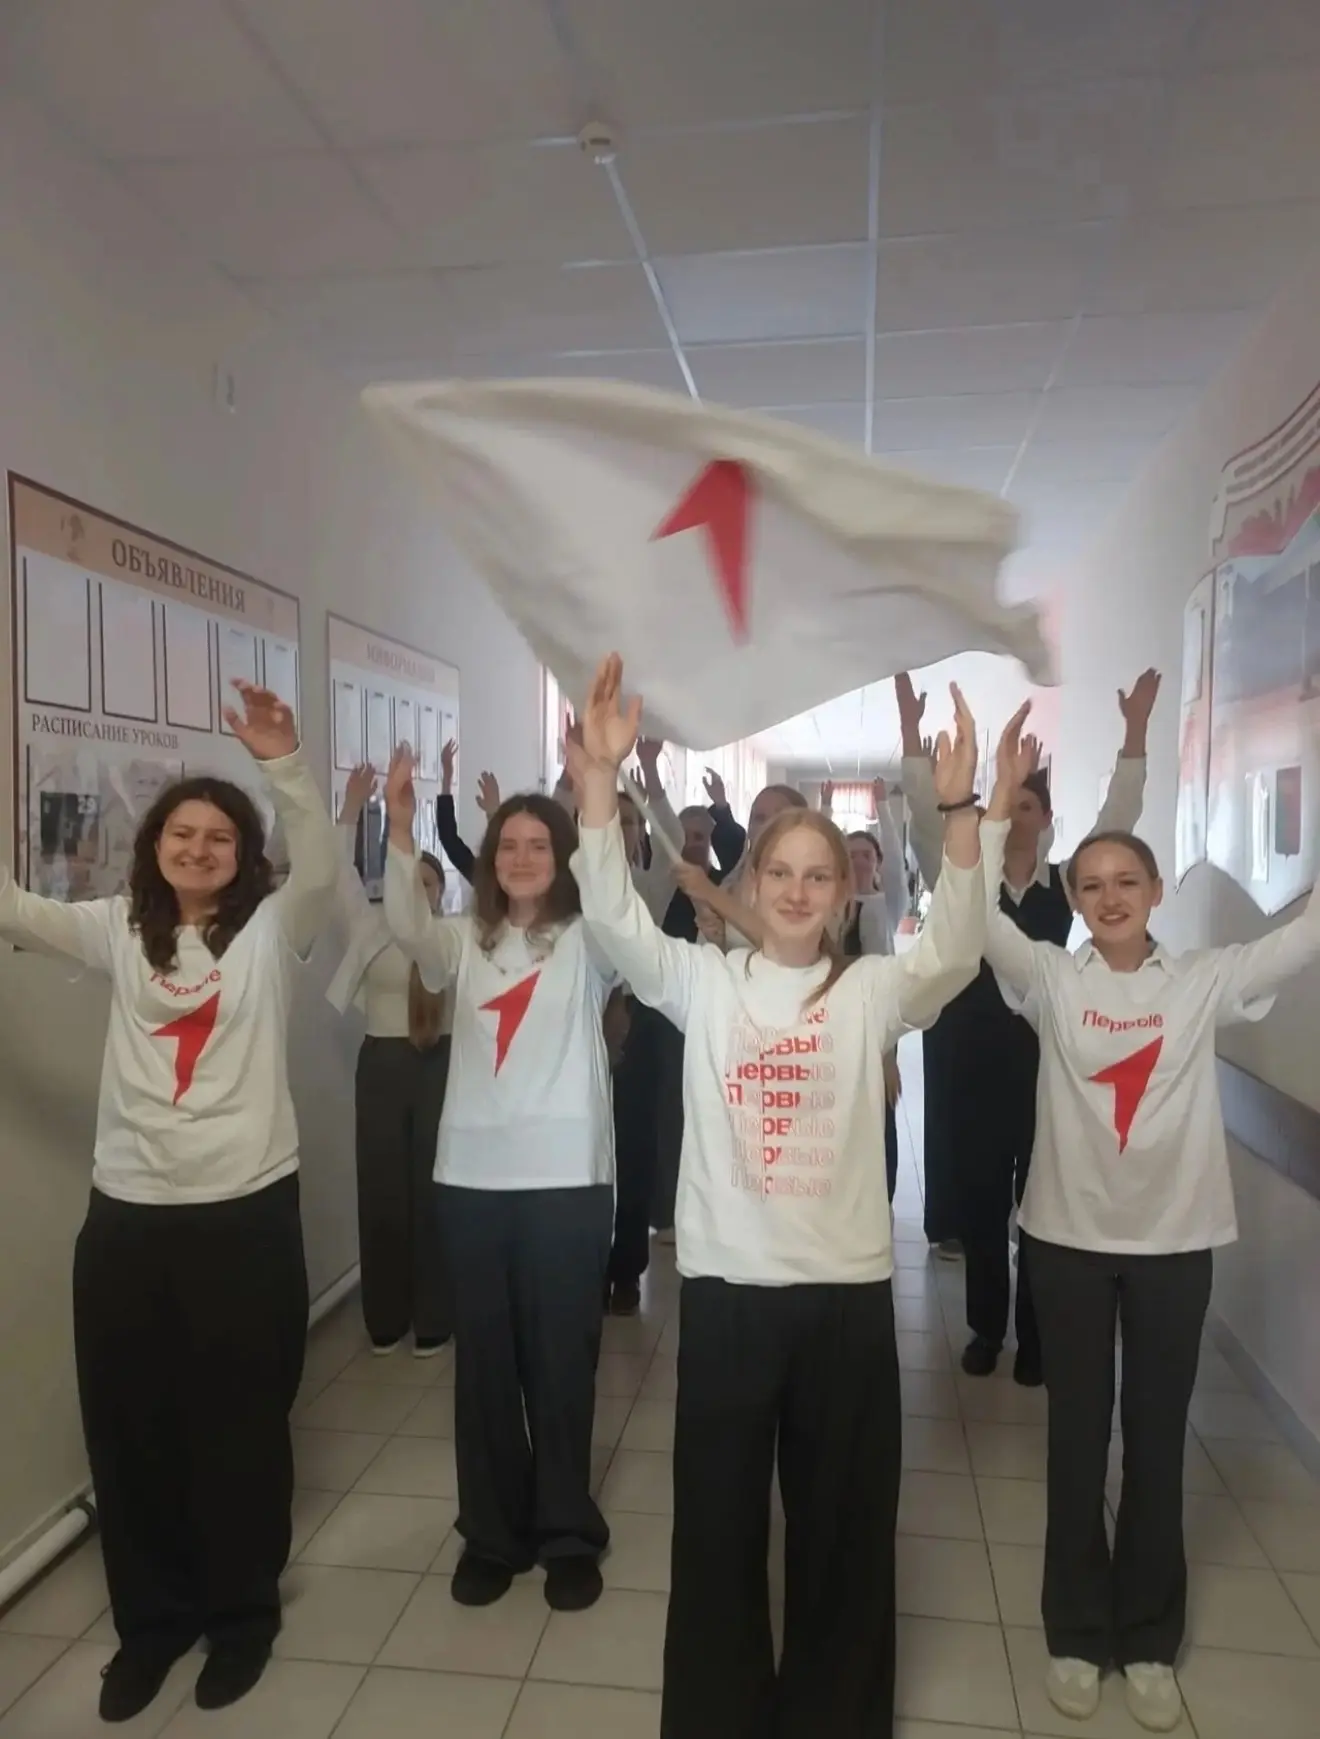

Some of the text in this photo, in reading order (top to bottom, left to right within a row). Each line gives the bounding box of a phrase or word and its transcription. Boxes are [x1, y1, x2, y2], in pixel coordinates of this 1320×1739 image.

[112, 538, 245, 613] ОБЪЯВЛЕНИЯ
[31, 713, 178, 749] РАСПИСАНИЕ УРОКОВ
[1082, 1009, 1164, 1034] Первые
